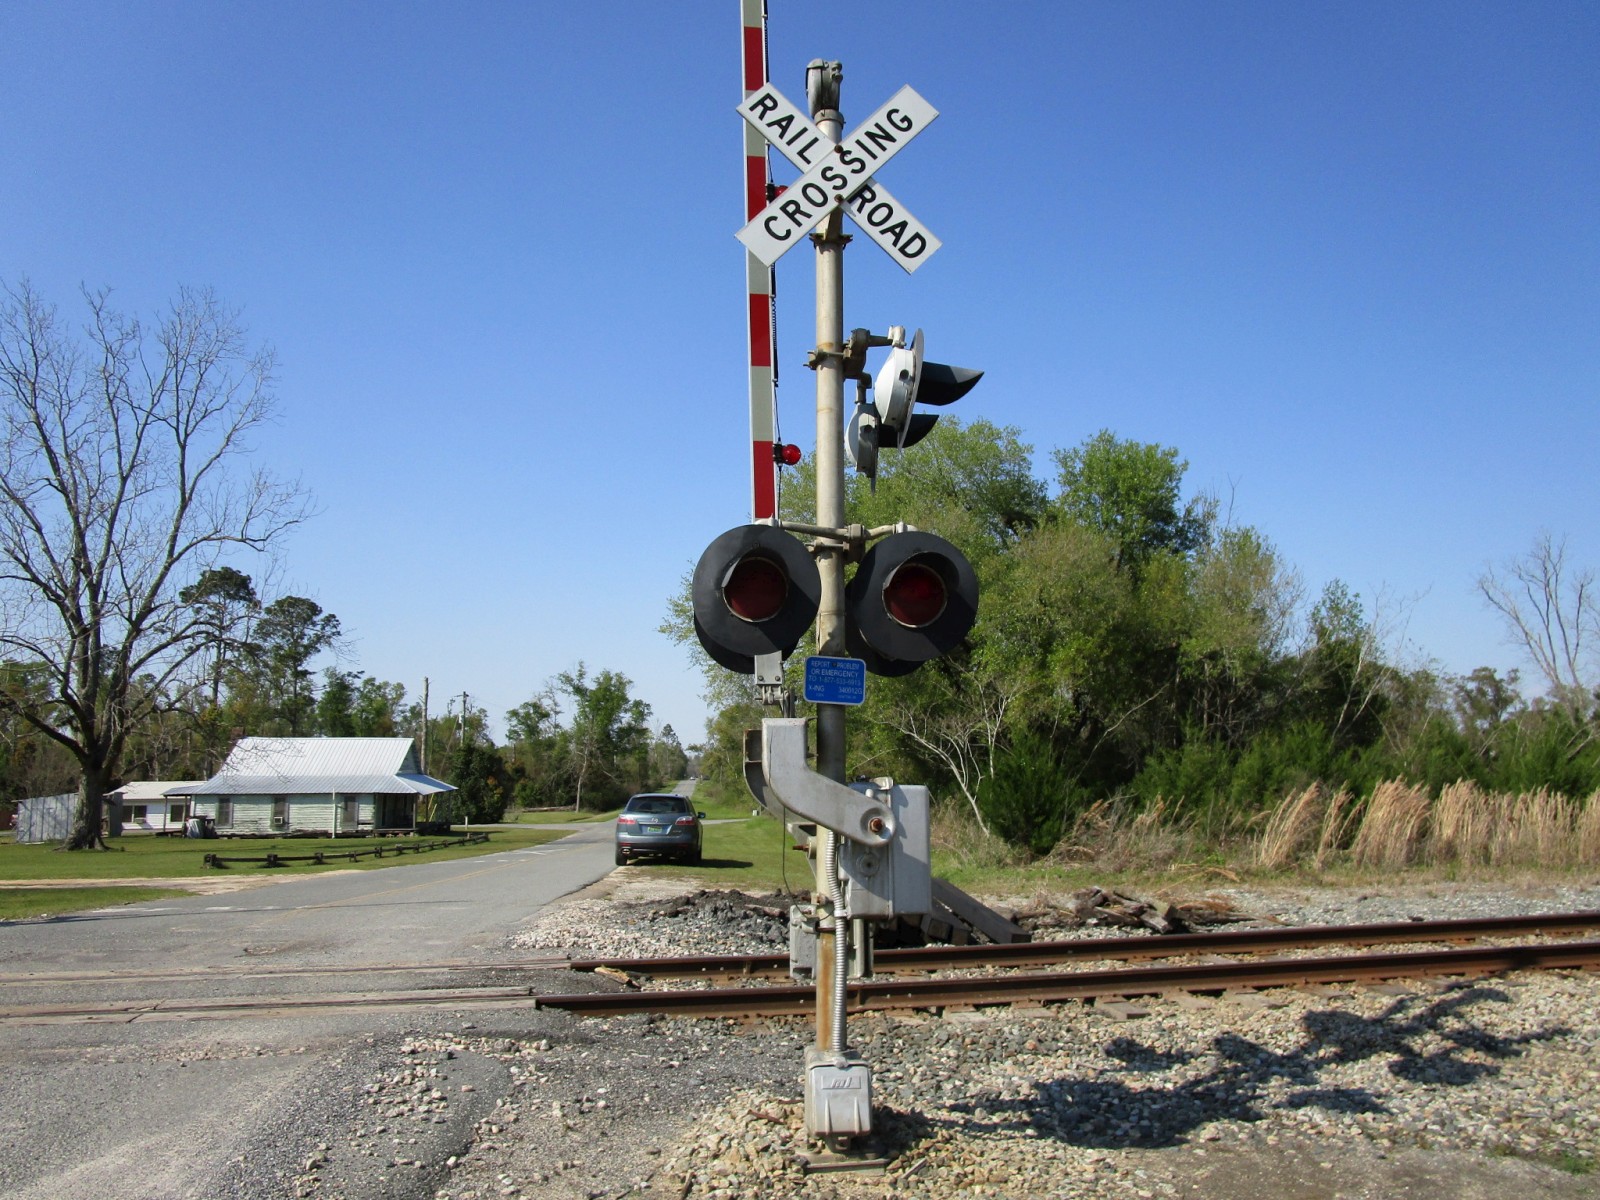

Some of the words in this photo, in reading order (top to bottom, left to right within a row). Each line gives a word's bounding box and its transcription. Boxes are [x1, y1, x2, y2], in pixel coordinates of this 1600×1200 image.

[749, 92, 819, 165] RAIL
[847, 184, 927, 259] ROAD
[764, 108, 913, 241] CROSSING
[811, 660, 830, 668] REPORT
[837, 661, 860, 670] PROBLEM
[821, 668, 858, 678] EMERGENCY
